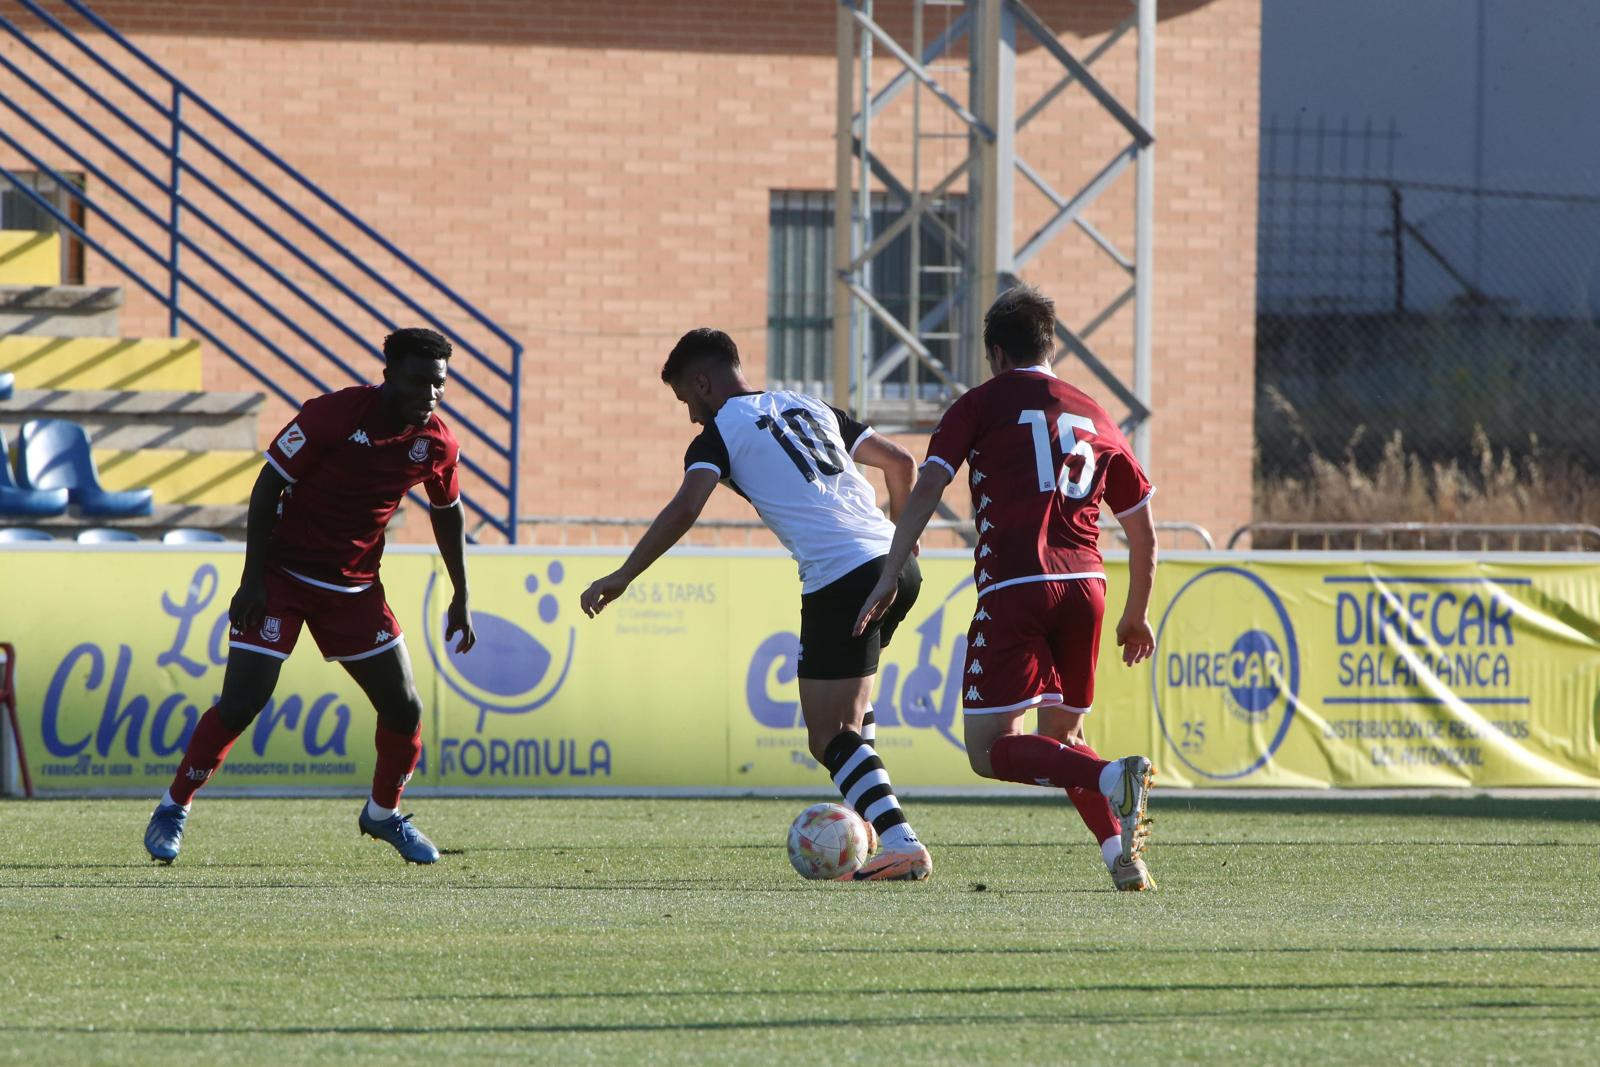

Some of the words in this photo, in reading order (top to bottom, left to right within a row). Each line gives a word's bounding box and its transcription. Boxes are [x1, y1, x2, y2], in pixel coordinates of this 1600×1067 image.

[755, 407, 844, 483] 10
[1017, 409, 1098, 499] 15
[667, 583, 717, 604] TAPAS
[1336, 591, 1514, 646] DIRECAR
[1168, 652, 1281, 688] DIRECAR
[41, 642, 351, 758] Chara
[1449, 719, 1530, 739] RECIOS
[440, 738, 611, 776] FORMULA
